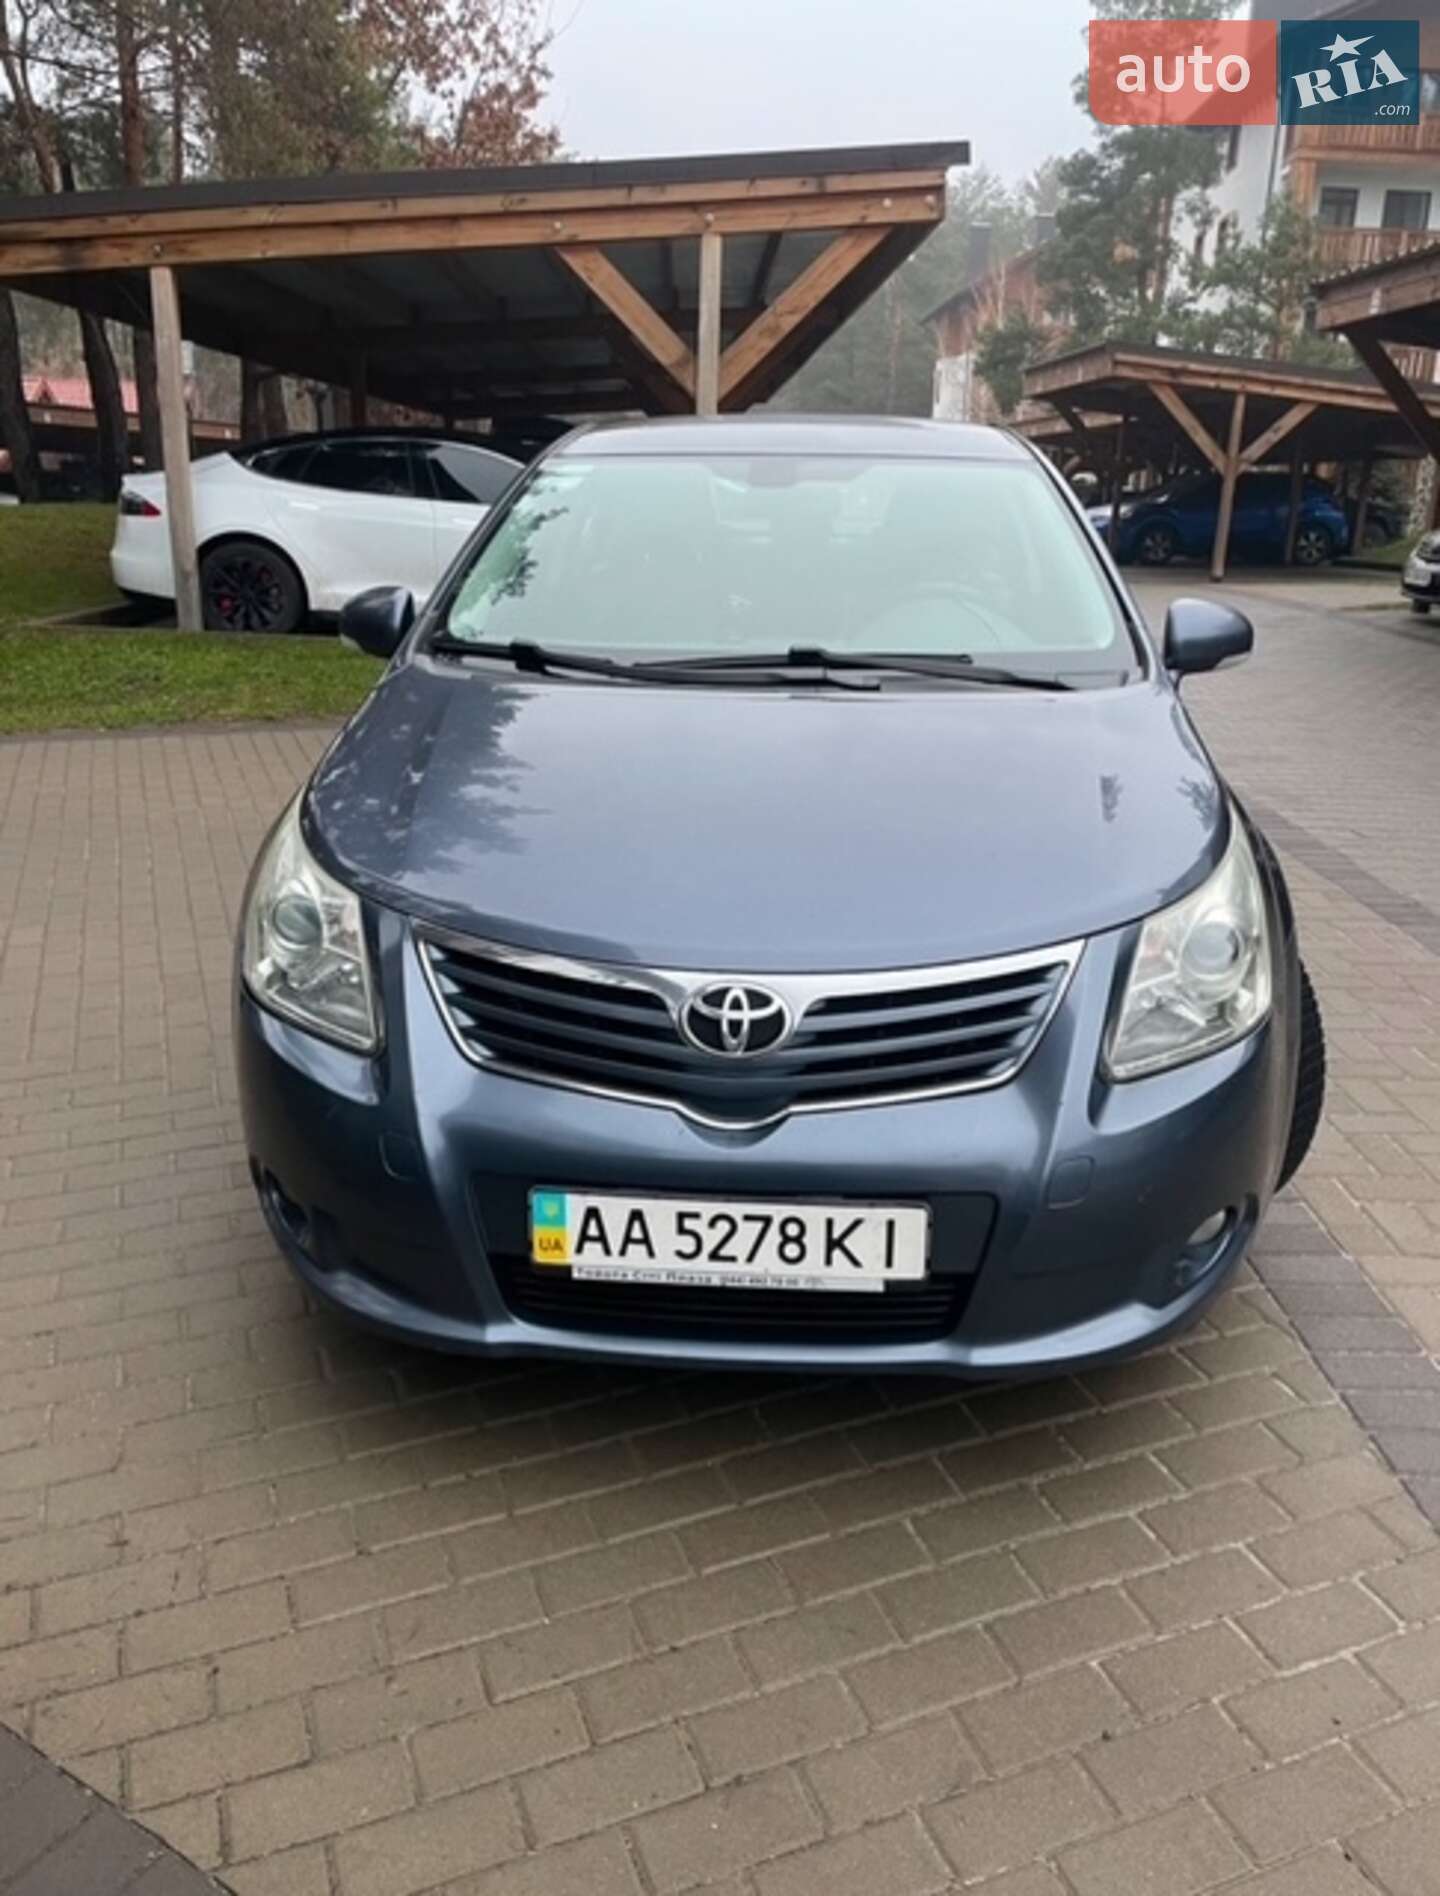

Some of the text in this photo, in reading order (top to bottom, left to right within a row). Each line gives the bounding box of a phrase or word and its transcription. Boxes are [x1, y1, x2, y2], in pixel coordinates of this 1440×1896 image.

[538, 1236, 564, 1251] UA
[575, 1206, 655, 1258] AA
[674, 1211, 807, 1266] 5278
